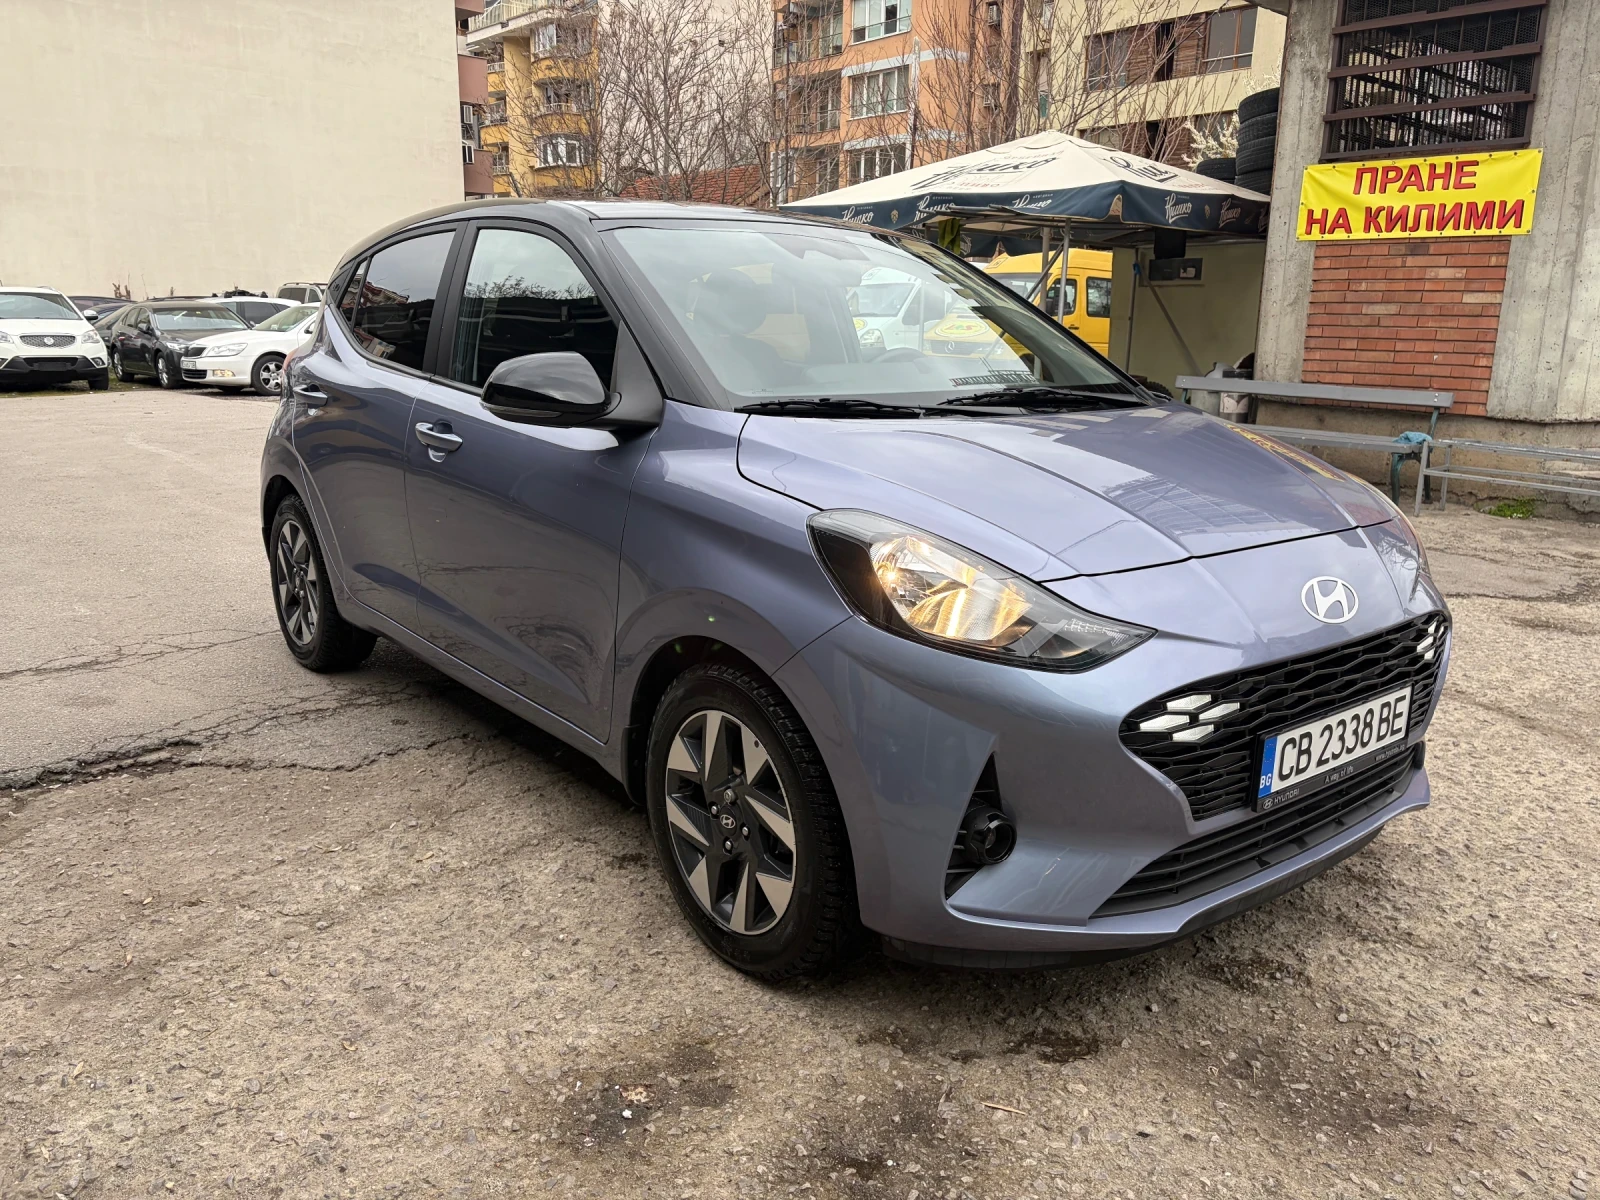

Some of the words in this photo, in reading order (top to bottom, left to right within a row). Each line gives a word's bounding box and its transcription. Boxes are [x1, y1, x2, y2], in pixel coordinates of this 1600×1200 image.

[1353, 160, 1479, 195] ПРАНЕ
[1304, 207, 1353, 235] НА
[1363, 199, 1525, 233] КИЛИМИ
[1278, 731, 1313, 781] CB
[1316, 708, 1375, 768] 2338
[1376, 694, 1407, 743] BE
[1260, 773, 1272, 789] BG
[1274, 788, 1300, 804] HYUNDAI
